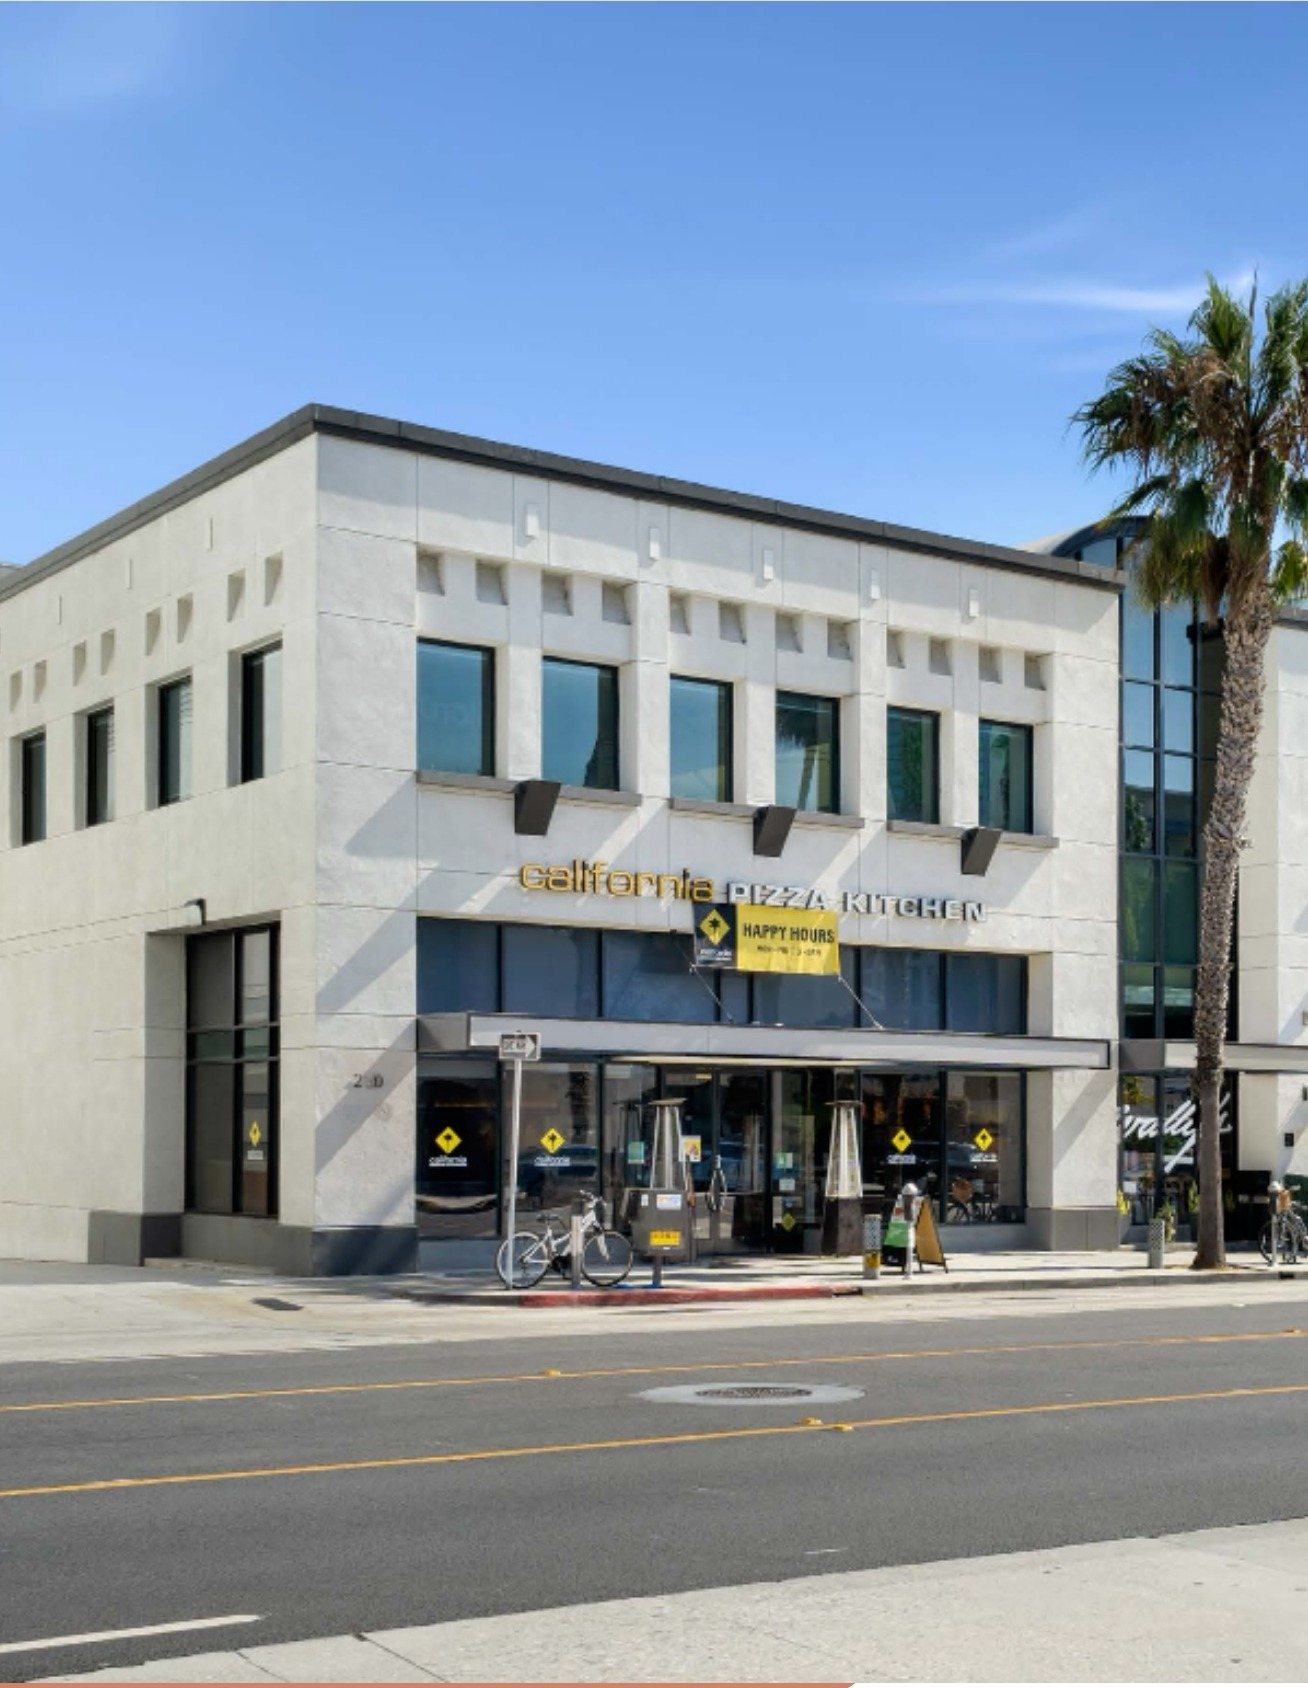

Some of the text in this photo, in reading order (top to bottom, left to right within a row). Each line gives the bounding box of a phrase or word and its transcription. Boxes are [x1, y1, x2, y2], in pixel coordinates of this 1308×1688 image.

[520, 858, 988, 924] california PIZZA KITCHEN
[743, 922, 836, 944] HAPPY HOURS
[351, 1073, 384, 1089] 20
